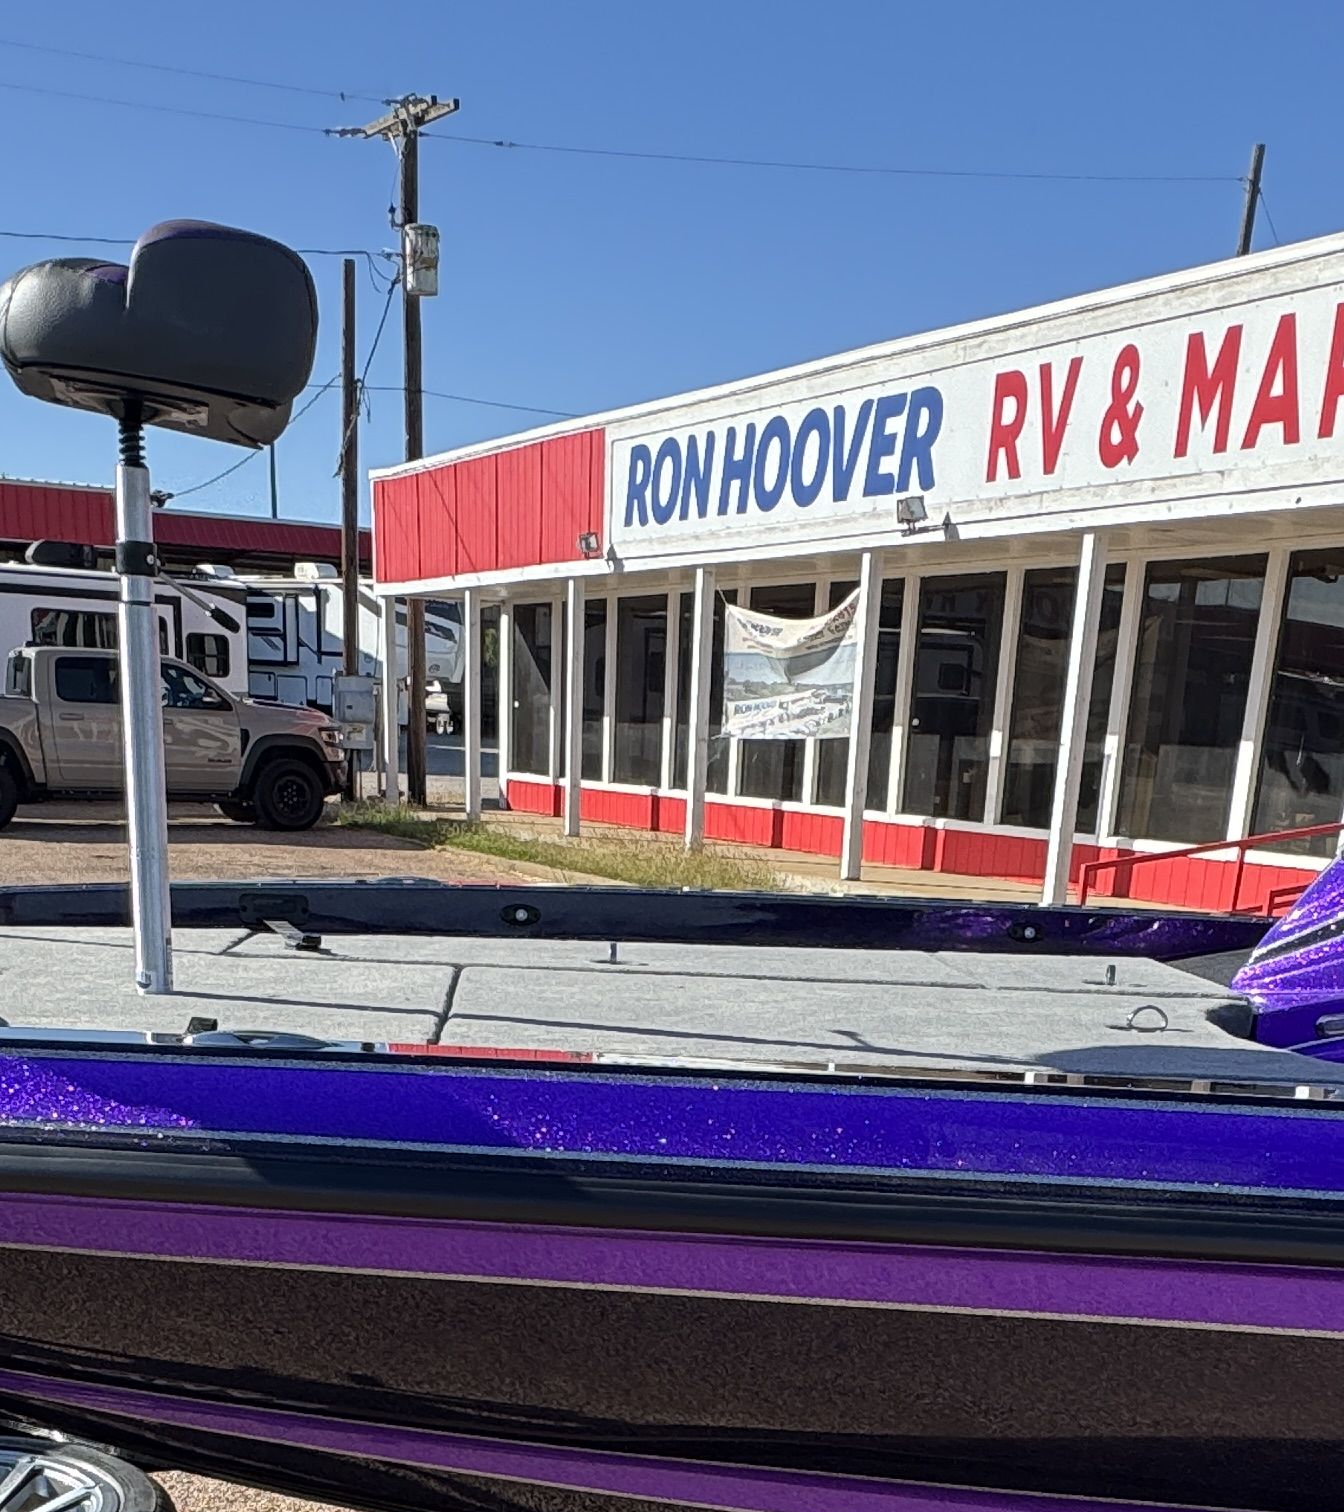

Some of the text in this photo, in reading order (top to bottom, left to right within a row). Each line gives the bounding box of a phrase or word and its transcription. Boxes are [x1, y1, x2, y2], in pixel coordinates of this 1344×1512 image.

[623, 385, 944, 528] RON HOOVER
[985, 356, 1083, 482] RV
[1097, 343, 1144, 468] &
